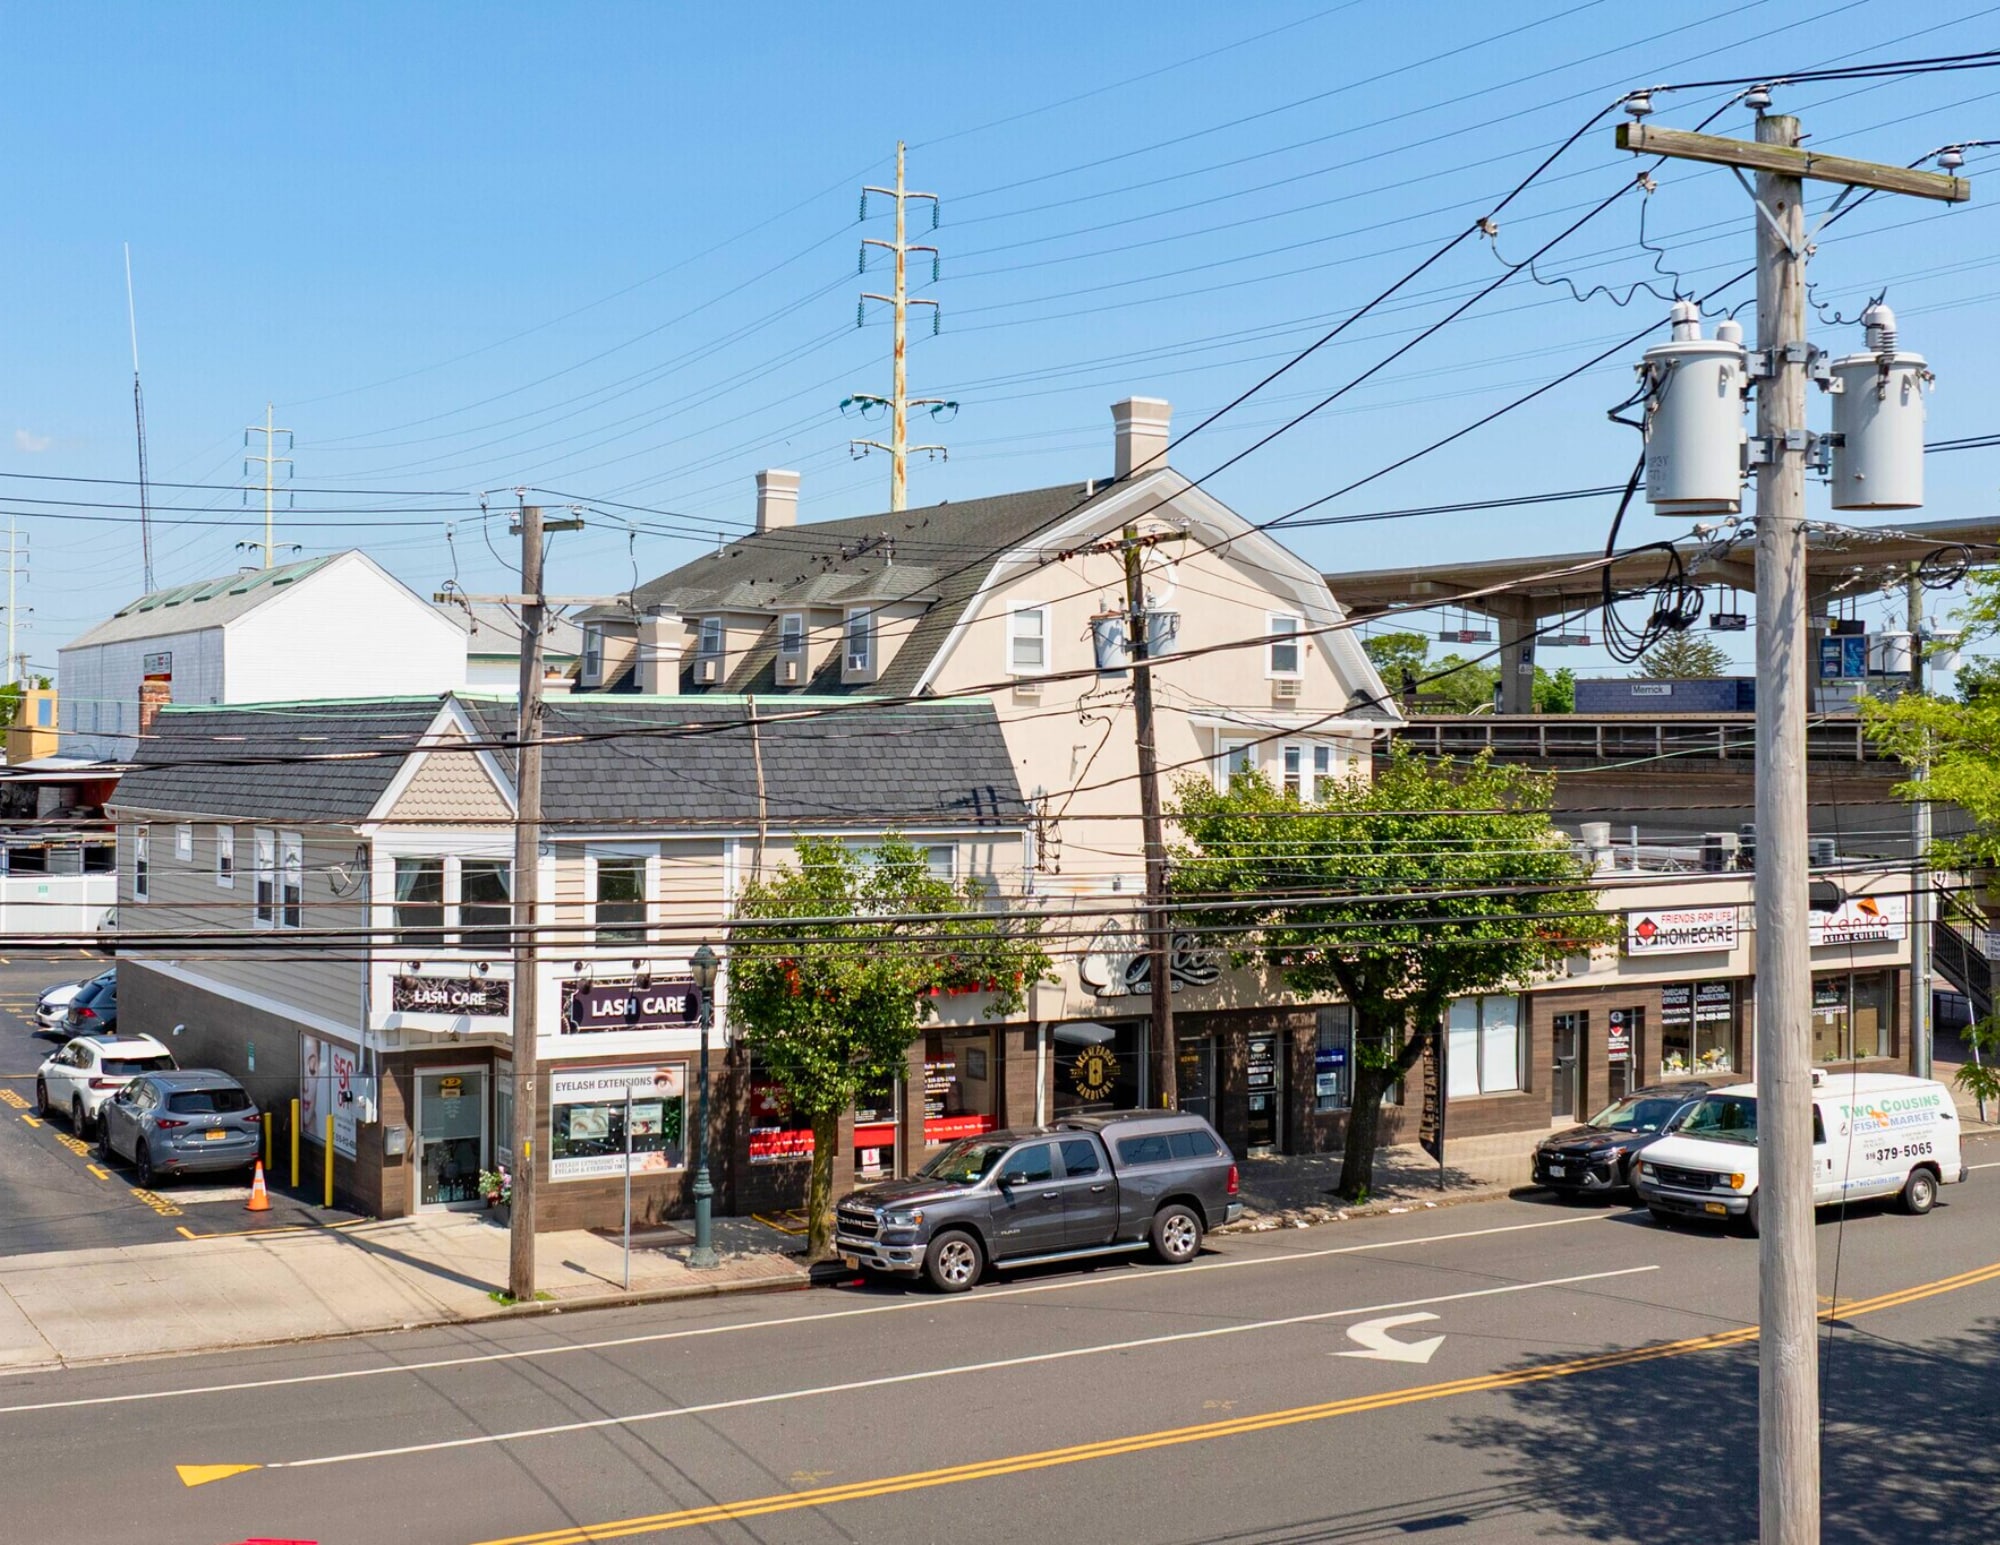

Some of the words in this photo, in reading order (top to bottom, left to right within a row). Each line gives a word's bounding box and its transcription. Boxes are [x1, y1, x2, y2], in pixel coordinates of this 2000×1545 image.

[1633, 684, 1664, 694] Merrick
[1661, 913, 1695, 924] FRIENDS
[1698, 912, 1714, 921] FOR
[1716, 911, 1732, 922] LIFE
[1824, 912, 1889, 932] Kenko
[1660, 926, 1733, 945] HOMECARE
[1824, 934, 1850, 943] ASIAN
[414, 990, 448, 1005] LASH
[452, 992, 487, 1006] CARE
[1662, 988, 1690, 997] OMECARE
[1663, 996, 1688, 1004] ERVICES
[592, 999, 637, 1017] LASH
[642, 996, 687, 1014] CARE
[556, 1080, 595, 1092] EYELASH
[598, 1077, 652, 1088] EXTENSIONS
[1854, 1120, 1880, 1132] FISH
[1890, 1112, 1936, 1126] MARKET
[1877, 1142, 1933, 1161] 379-5065
[555, 1167, 579, 1175] EYELASH
